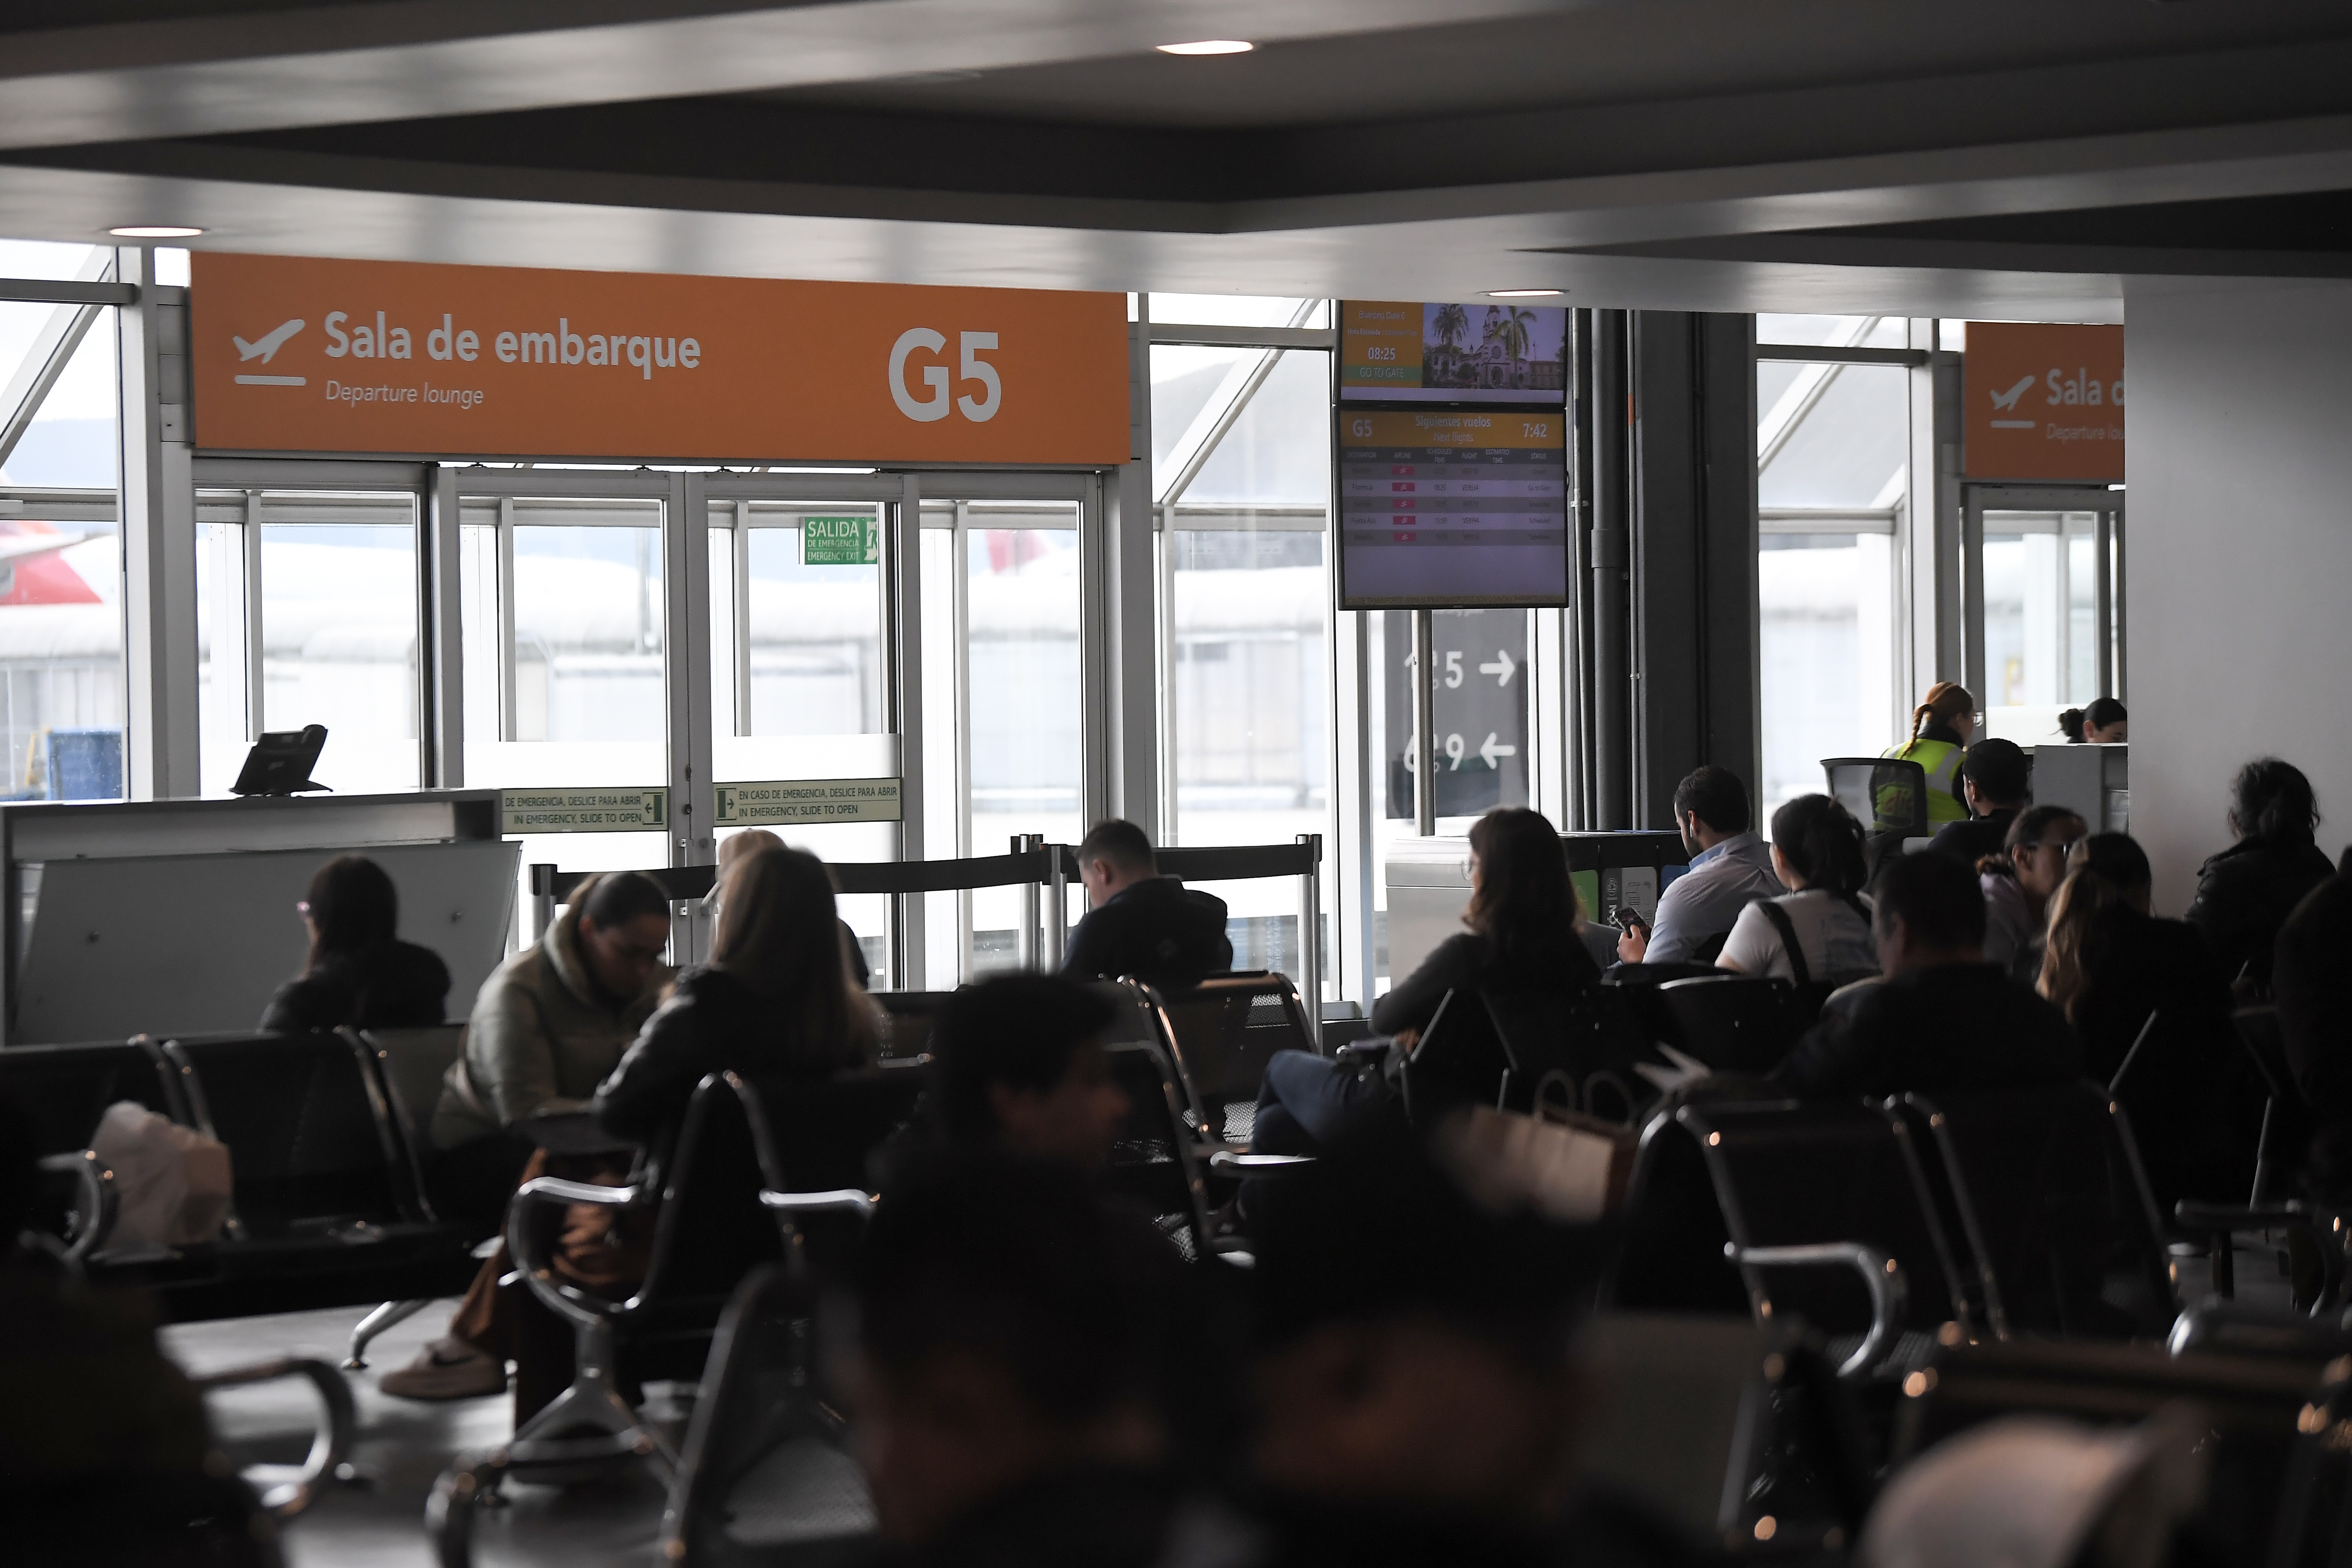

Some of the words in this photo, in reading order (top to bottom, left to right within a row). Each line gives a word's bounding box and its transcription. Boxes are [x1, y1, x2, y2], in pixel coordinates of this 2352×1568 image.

[1359, 311, 1385, 321] Boarding
[1386, 311, 1400, 320] Gate
[324, 311, 412, 360] Sala
[427, 313, 480, 362] de
[495, 317, 701, 380] embarque
[1368, 347, 1396, 360] 08:25
[887, 326, 1002, 425] G5
[1360, 367, 1372, 378] GO
[1373, 368, 1383, 378] TO
[1386, 368, 1404, 378] GATE
[2047, 367, 2102, 406] Sala
[326, 379, 418, 408] Departure
[423, 381, 483, 410] lounge
[1352, 419, 1373, 438] G5
[1416, 415, 1461, 430] Siguientes
[1463, 416, 1491, 427] vuelos
[1523, 423, 1547, 438] 7:42
[2047, 423, 2105, 445] Departure
[1434, 432, 1450, 442] Next
[1452, 431, 1474, 445] flights
[807, 521, 859, 538] SALIDA
[818, 539, 859, 547] EMERGENCIA
[807, 552, 844, 561] EMERGENCY
[846, 552, 859, 560] EXIT
[739, 791, 748, 799] EN
[751, 790, 770, 799] CASO
[772, 790, 781, 799] DE
[783, 788, 828, 799] EMERGENCIA,
[830, 788, 856, 797] DESLICE
[858, 787, 875, 797] PARA
[877, 787, 897, 796] ABRIR
[505, 797, 515, 807] DE
[517, 797, 566, 807] EMERGENCIA,
[568, 796, 596, 806] DESLICE
[598, 796, 617, 806] PARA
[620, 796, 641, 805] ABRIR
[739, 807, 748, 817] IN
[750, 806, 798, 817] EMERGENCY,
[801, 806, 821, 815] SLIDE
[824, 805, 835, 815] TO
[837, 805, 859, 814] OPEN
[514, 815, 523, 824] IN
[526, 814, 577, 824] EMERGENCY,
[580, 814, 602, 823] SLIDE
[605, 814, 616, 822] TO
[619, 813, 641, 822] OPEN
